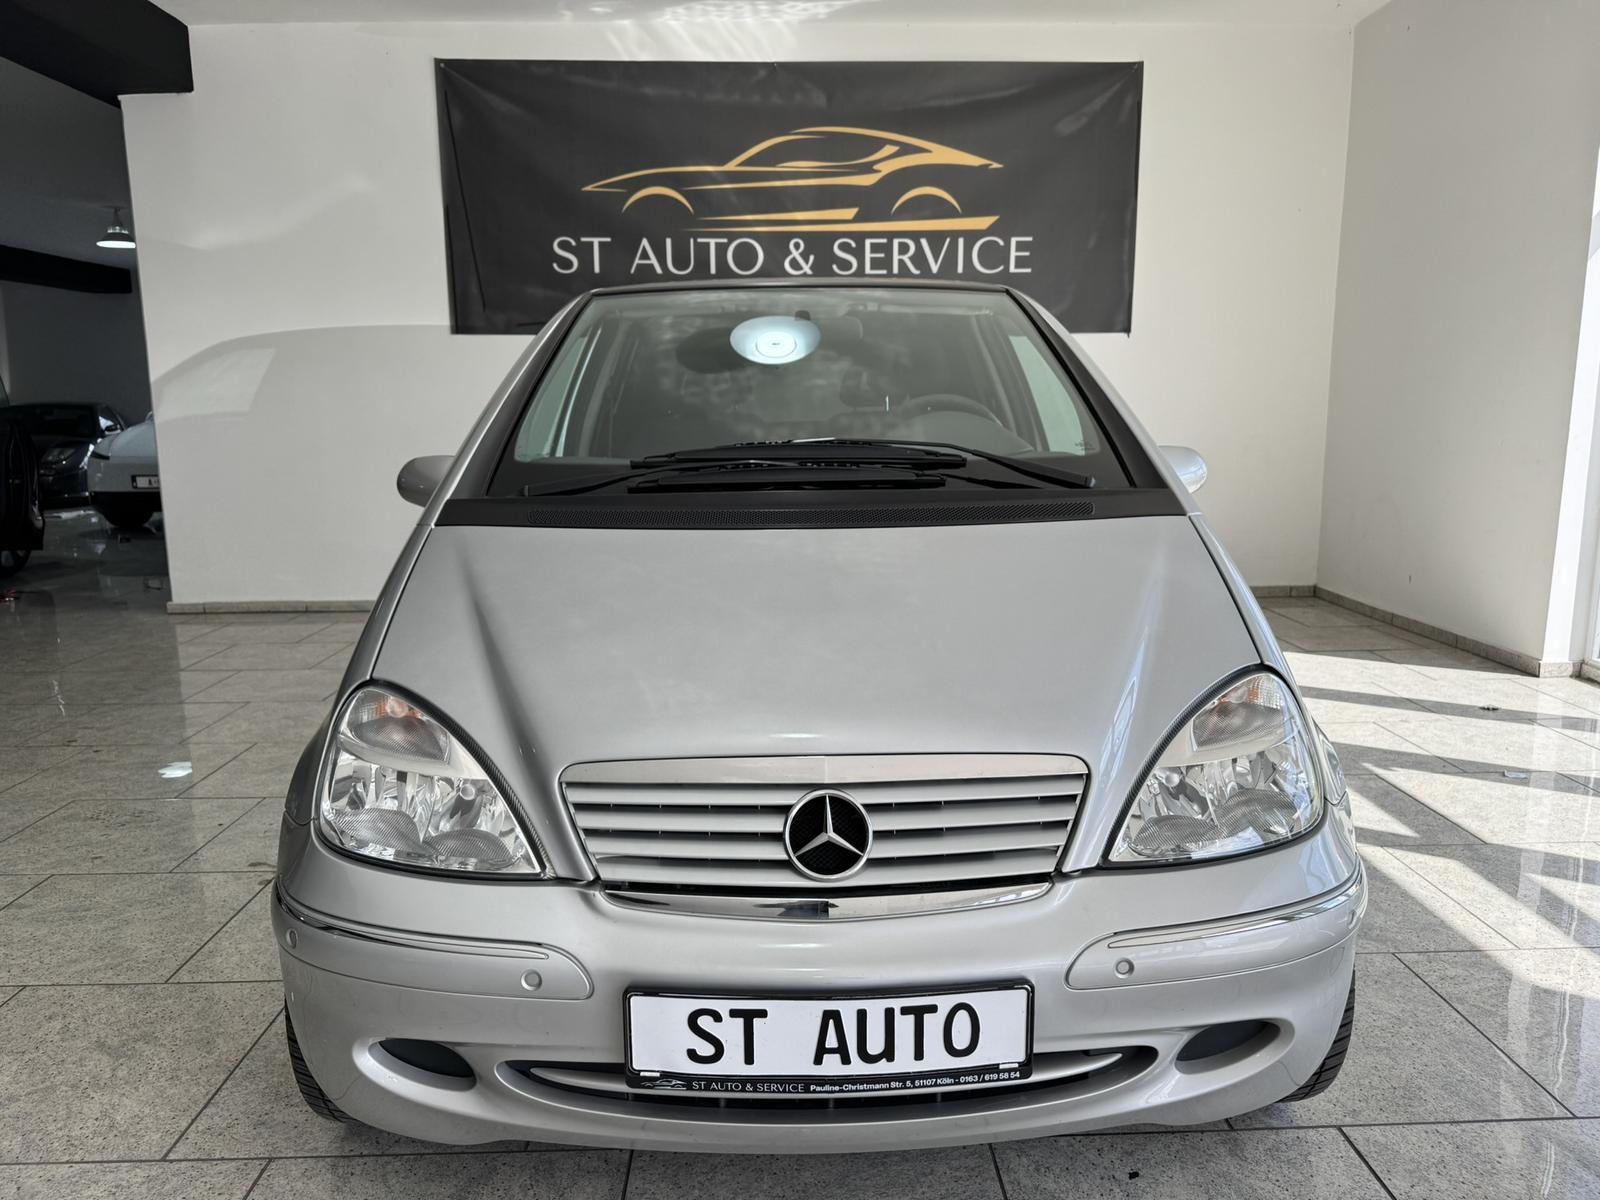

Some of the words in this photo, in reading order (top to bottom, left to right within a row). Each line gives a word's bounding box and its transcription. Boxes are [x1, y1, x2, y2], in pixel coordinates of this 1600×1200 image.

[551, 236, 612, 275] ST
[630, 236, 766, 276] AUTO
[783, 236, 815, 276] &
[831, 236, 1034, 276] SERVICE
[685, 1008, 769, 1066] ST
[812, 1001, 981, 1066] AUTO
[692, 1081, 707, 1090] ST
[710, 1082, 742, 1091] AUTO
[745, 1082, 753, 1092] &
[756, 1082, 805, 1093] SERVICE
[810, 1082, 889, 1092] Pauline-Christmann
[890, 1081, 905, 1089] Str.
[915, 1078, 936, 1087] 51107
[937, 1076, 954, 1085] Köln
[960, 1075, 979, 1083] 0163
[984, 1072, 998, 1081] 619
[999, 1071, 1009, 1079] 58
